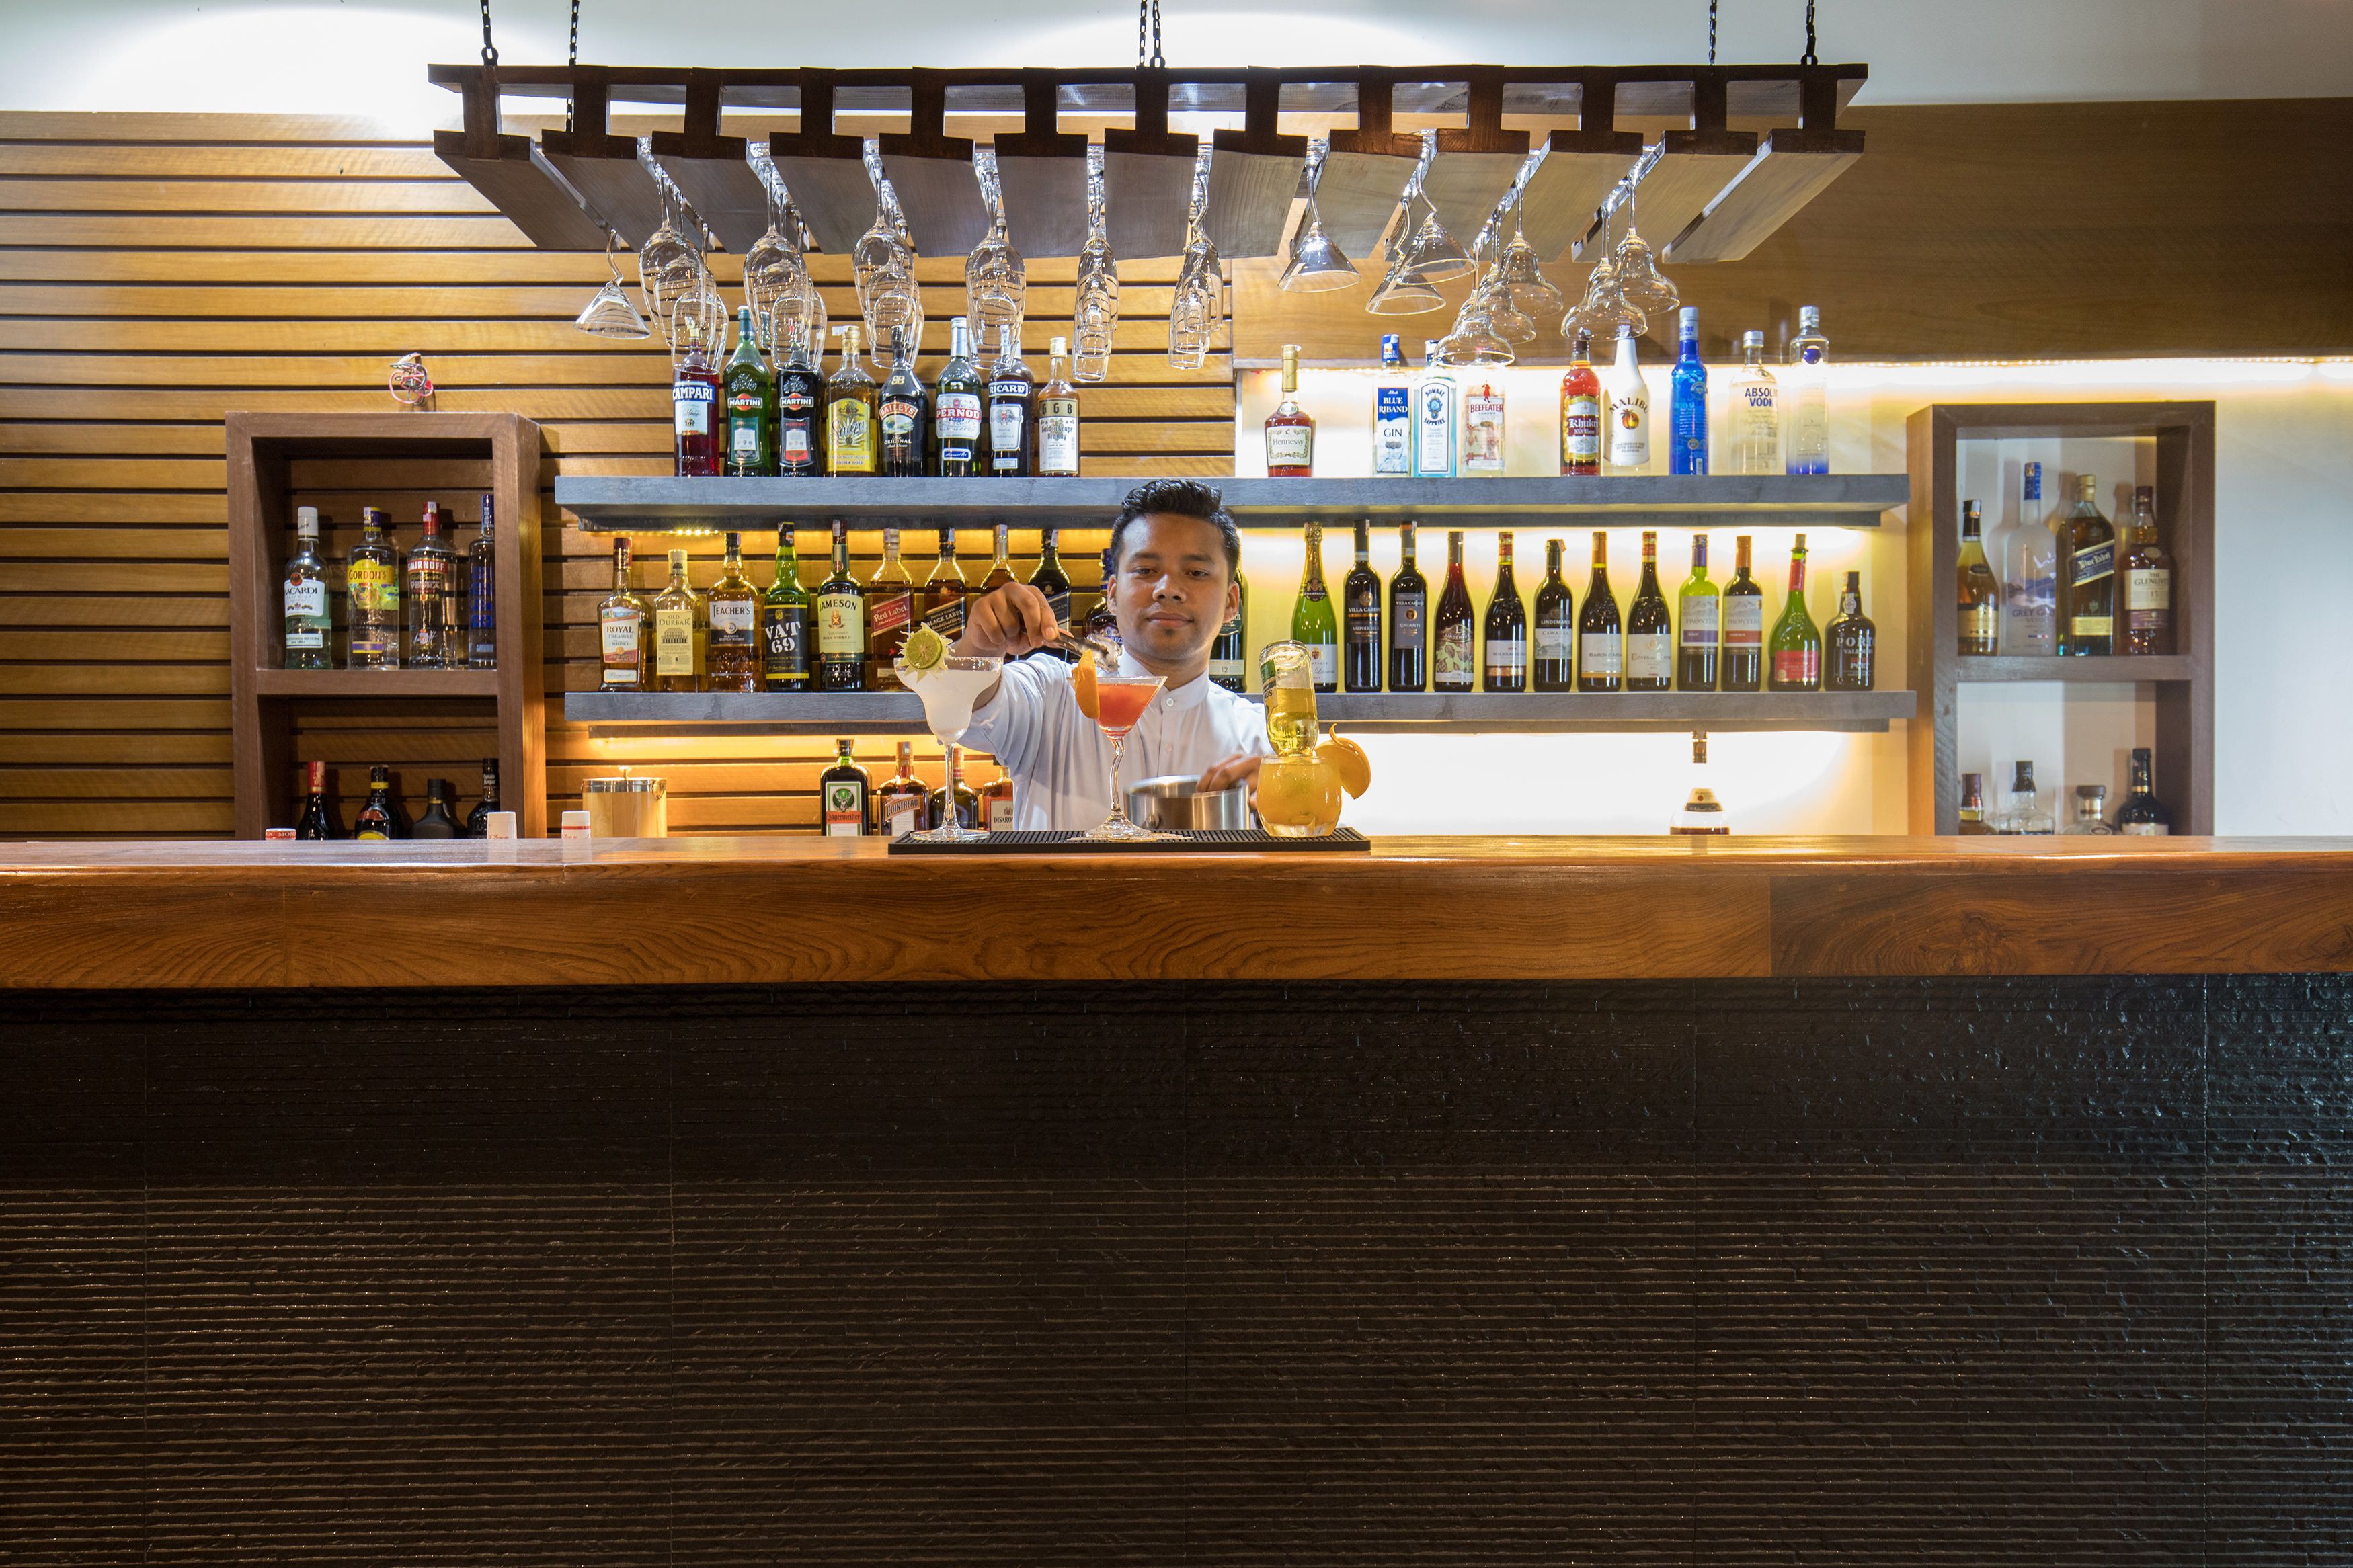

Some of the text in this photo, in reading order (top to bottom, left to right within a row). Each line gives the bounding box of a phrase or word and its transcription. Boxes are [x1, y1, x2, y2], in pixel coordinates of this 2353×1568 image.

[673, 387, 713, 401] CAMPARI
[990, 385, 1025, 394] RICARD
[1425, 388, 1445, 397] BOMBAY
[881, 403, 914, 417] BAILEYS
[1053, 403, 1059, 413] G
[1067, 403, 1072, 415] B
[1379, 406, 1408, 414] RIBAND
[1470, 404, 1504, 413] BEEFEATER
[1609, 397, 1649, 414] MALIBU
[936, 409, 980, 419] PERNOD
[1424, 417, 1445, 425] SAPPHIRE
[1384, 429, 1402, 437] GIN
[1273, 438, 1303, 447] Hennessy
[349, 569, 387, 581] GORDON'S
[286, 587, 317, 595] ACARDI
[713, 605, 750, 617] TEACHER'S
[820, 599, 857, 612] JAMESON
[874, 610, 889, 622] Red
[889, 604, 909, 616] Label
[945, 610, 963, 620] LABEL
[2013, 609, 2034, 617] GREY
[765, 621, 801, 641] VAT
[772, 638, 795, 654] 69
[887, 798, 918, 817] COINTREAU
